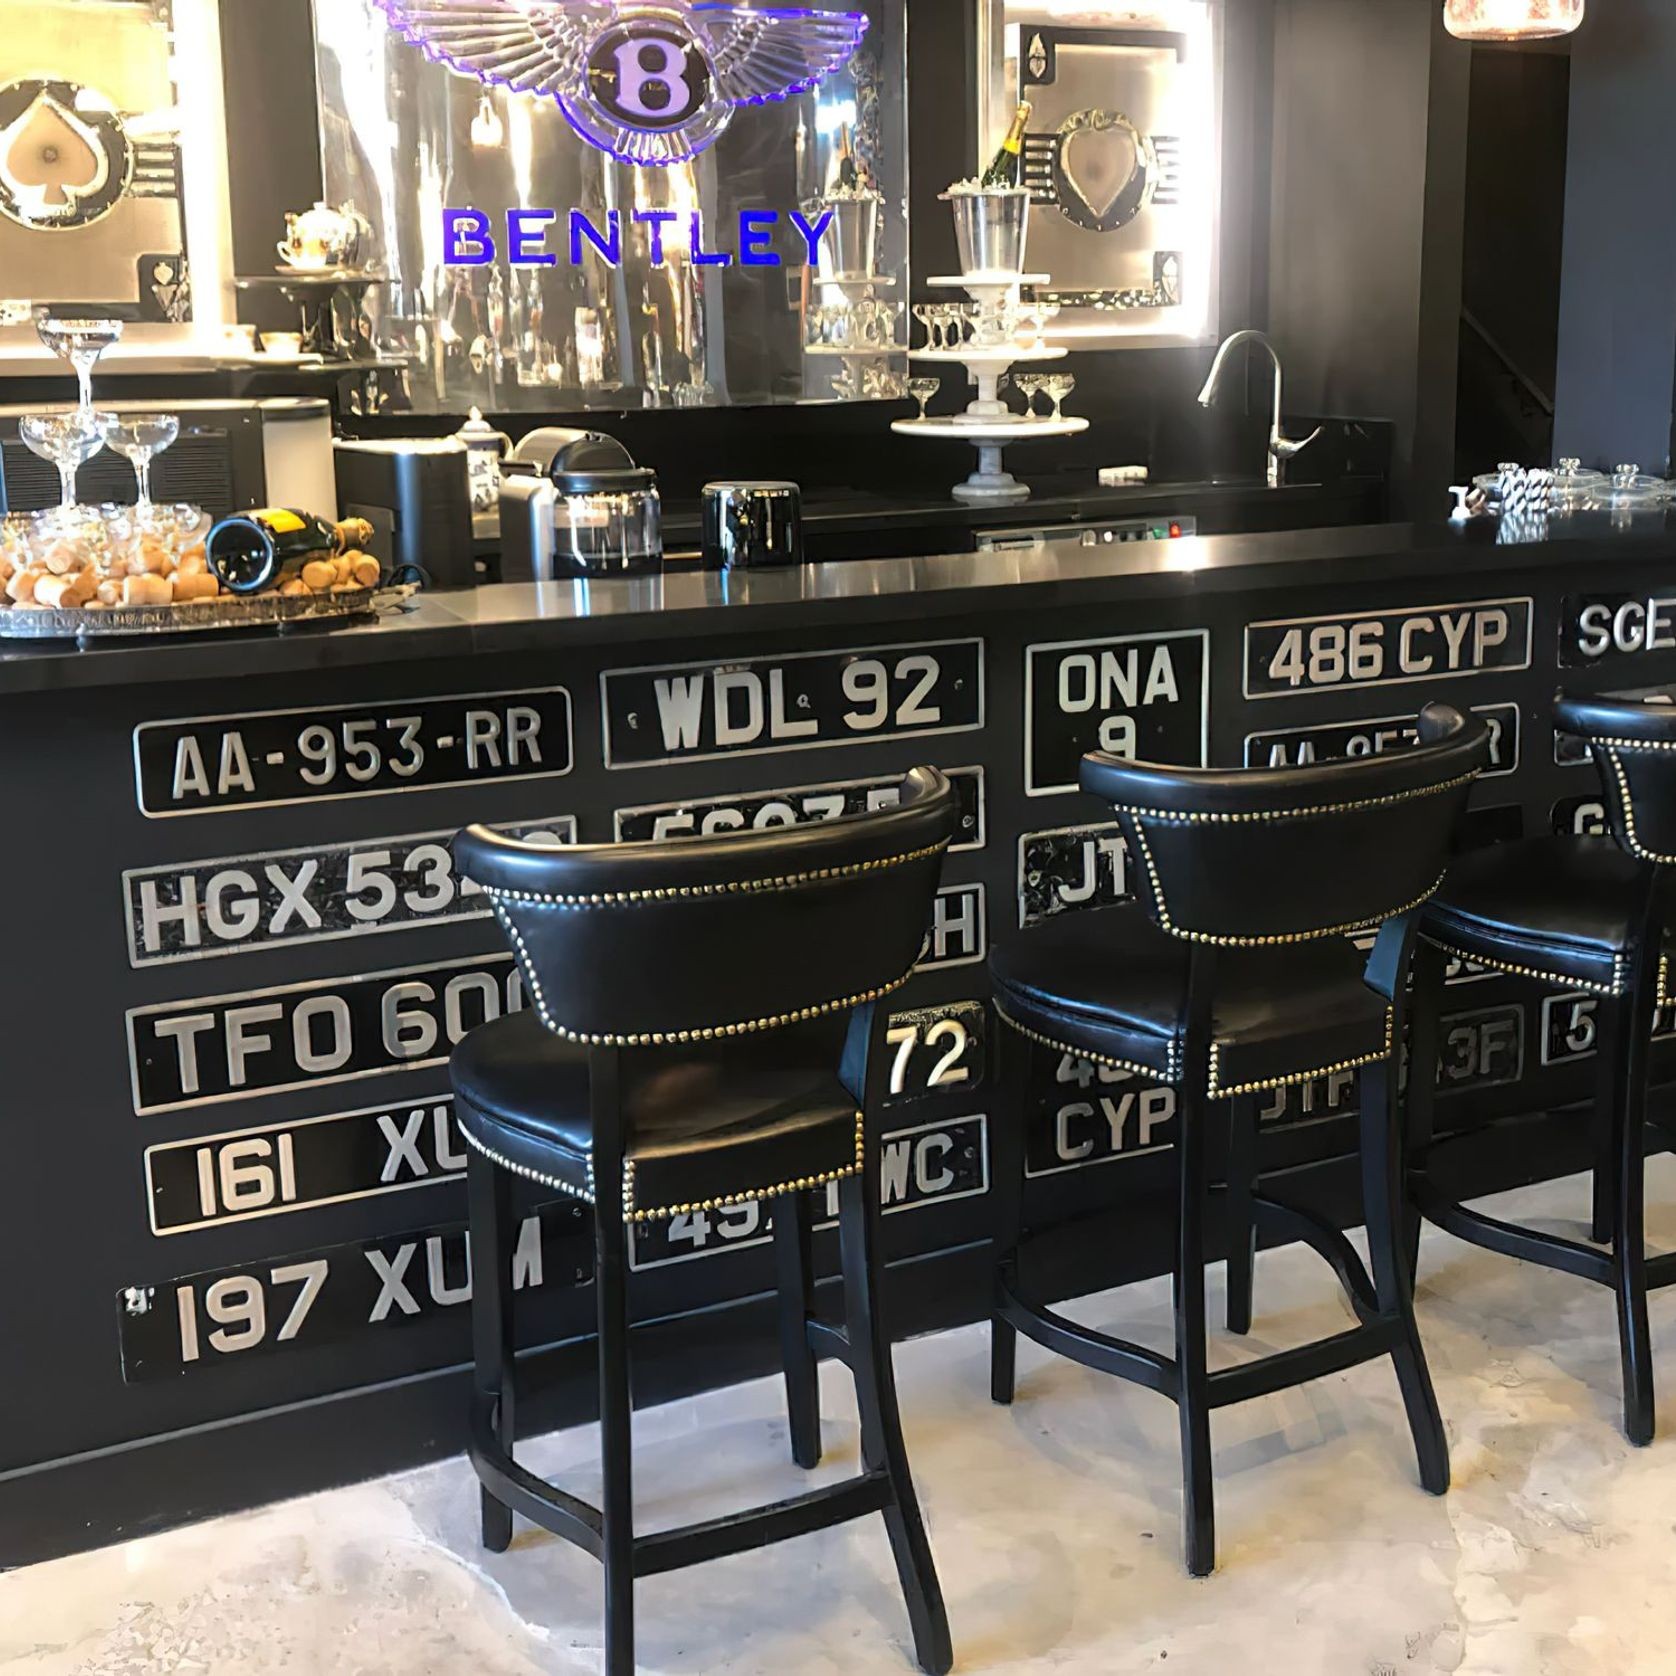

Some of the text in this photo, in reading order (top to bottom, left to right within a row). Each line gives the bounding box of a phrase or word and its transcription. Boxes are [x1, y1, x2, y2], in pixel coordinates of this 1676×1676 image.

[613, 37, 690, 118] B
[442, 207, 835, 268] BENTLEY
[1268, 609, 1508, 686] 486 CYP
[1578, 597, 1676, 657] SGE
[653, 655, 940, 751] WDL 92
[1058, 645, 1179, 713] ONA
[1099, 715, 1136, 760] 9
[139, 844, 483, 952] HGX 53
[154, 994, 353, 1093] TFO
[886, 1018, 969, 1095] 72
[1433, 1018, 1515, 1084] 3F
[1056, 1086, 1176, 1160] CYP
[196, 1132, 296, 1217] 161
[880, 1133, 954, 1201] WC
[176, 1259, 328, 1362] 197
